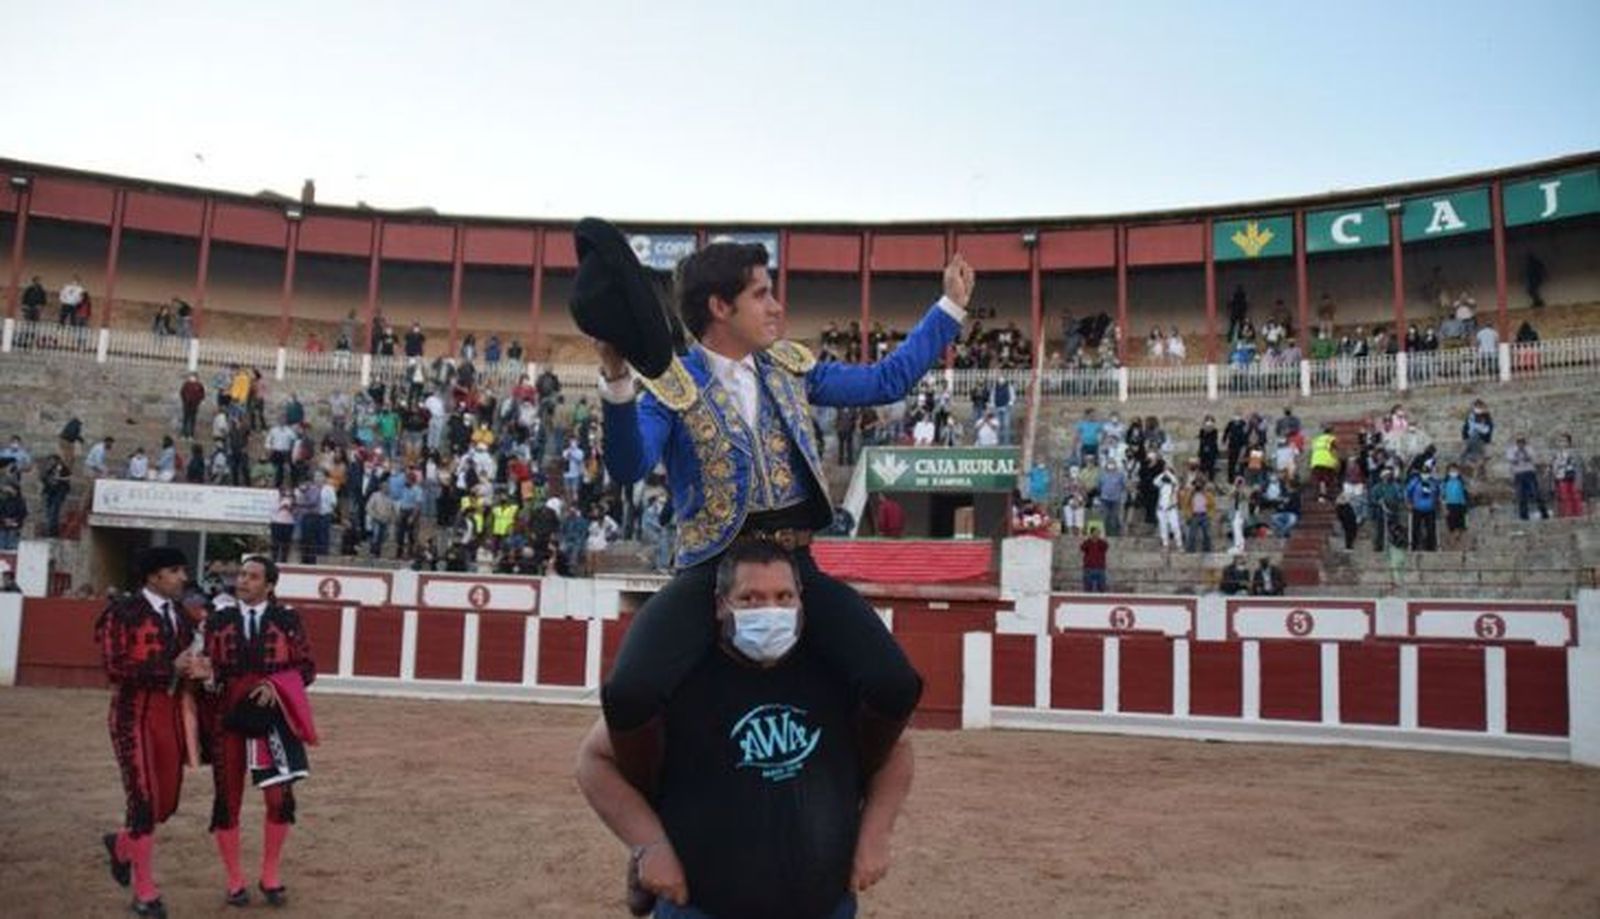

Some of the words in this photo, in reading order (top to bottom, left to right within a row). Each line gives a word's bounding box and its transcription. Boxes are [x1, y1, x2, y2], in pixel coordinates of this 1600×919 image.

[1331, 213, 1362, 244] C
[1425, 200, 1466, 233] A
[1539, 181, 1561, 217] J
